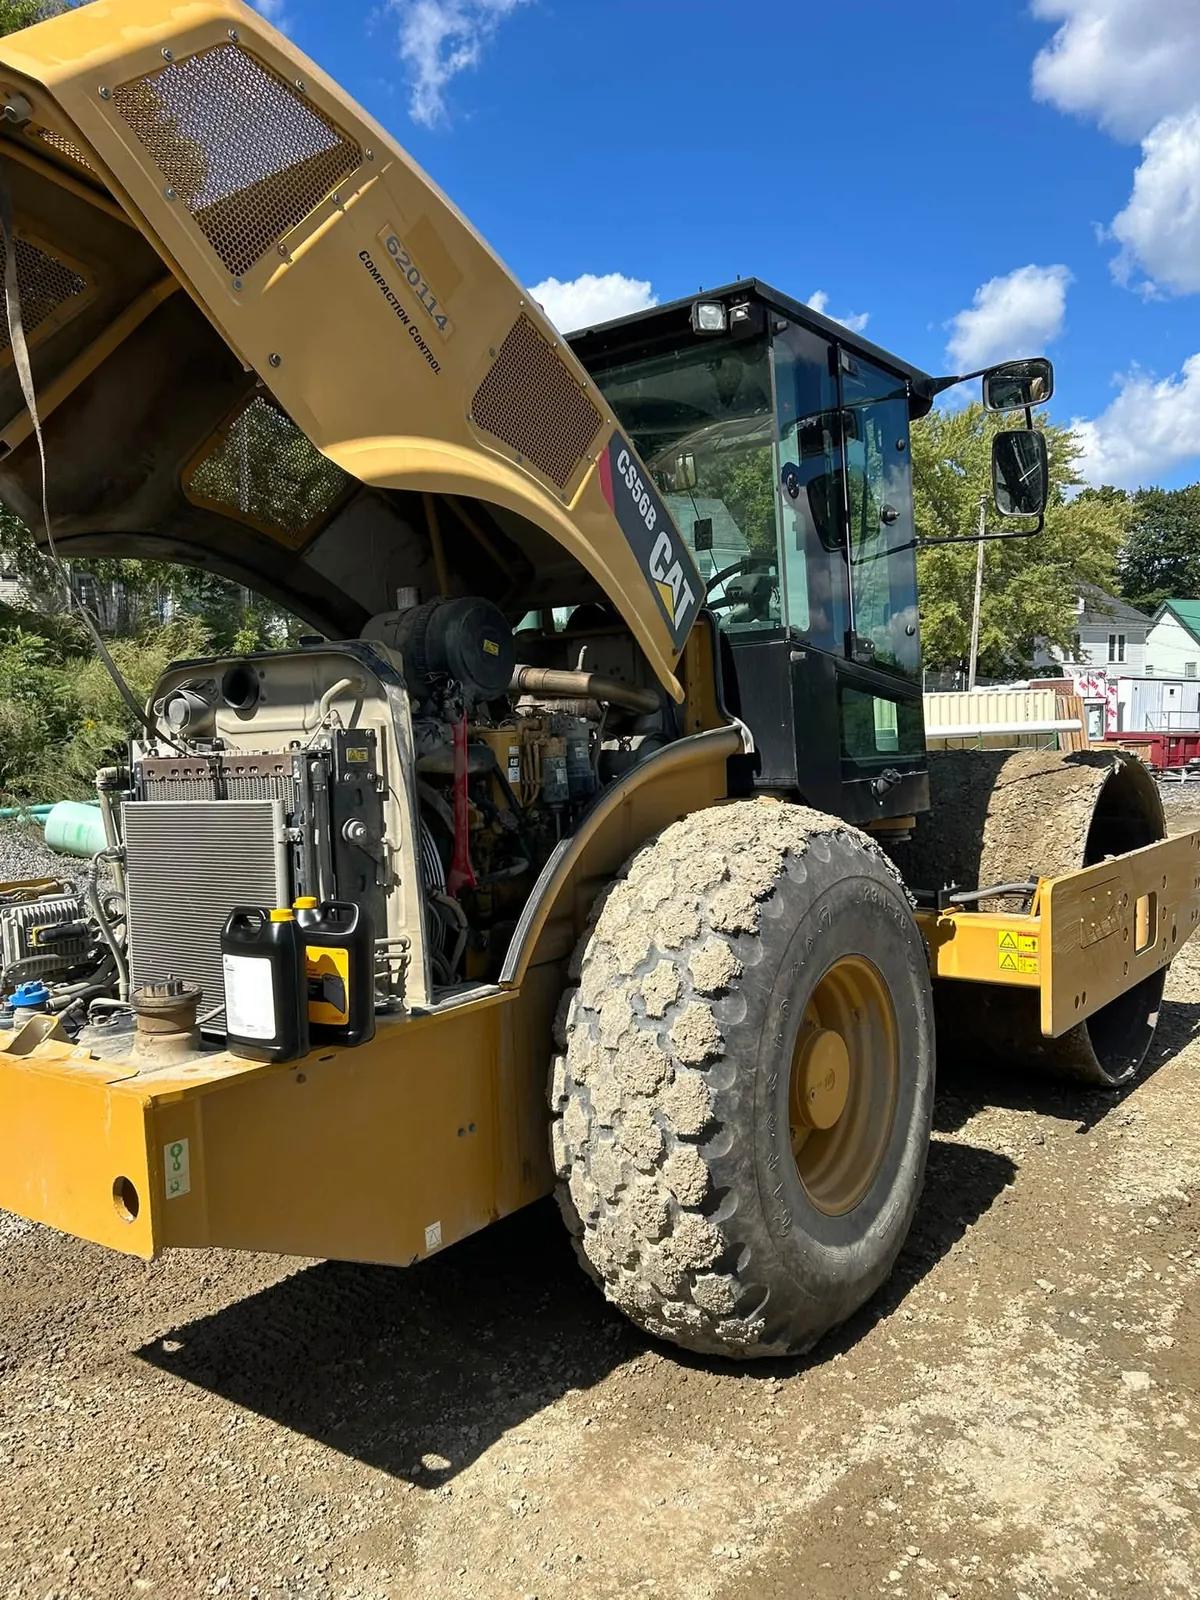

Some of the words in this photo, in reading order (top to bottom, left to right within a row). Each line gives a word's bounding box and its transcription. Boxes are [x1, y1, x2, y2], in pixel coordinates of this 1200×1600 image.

[359, 250, 410, 325] COMPACTION
[408, 326, 442, 375] CONTROL
[386, 236, 448, 331] 620114
[617, 450, 657, 530] CS56B
[649, 531, 695, 631] CAT
